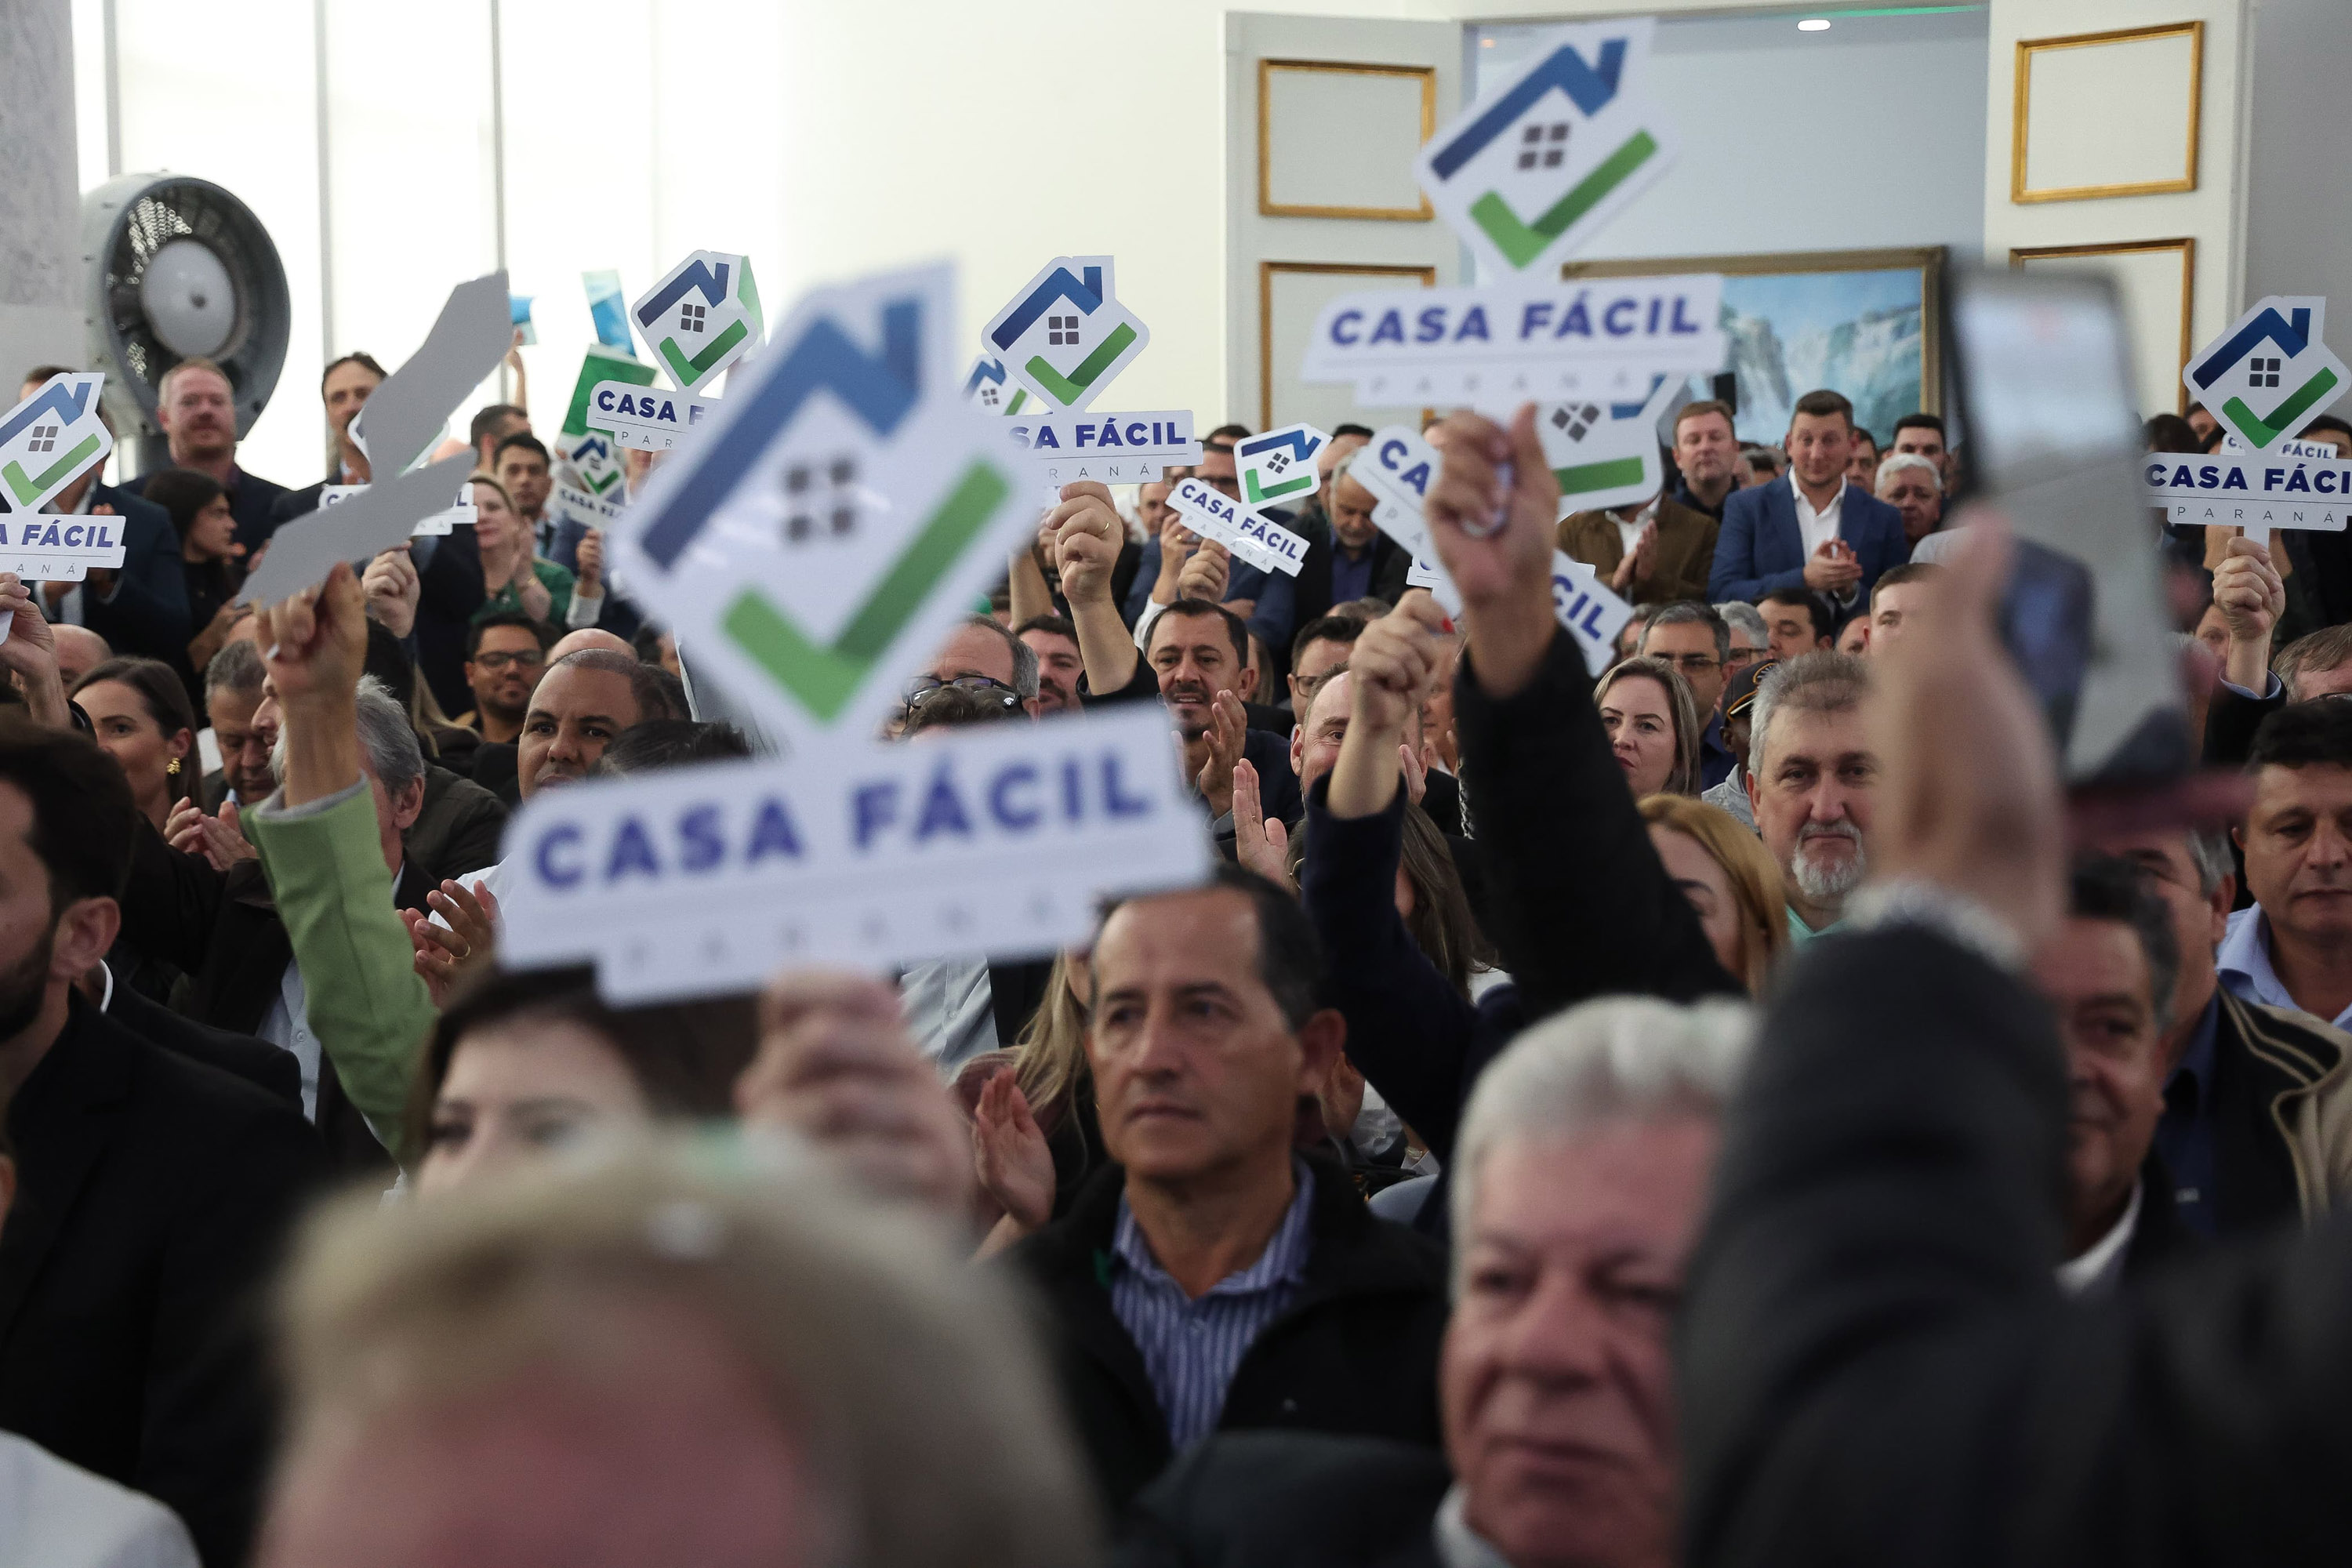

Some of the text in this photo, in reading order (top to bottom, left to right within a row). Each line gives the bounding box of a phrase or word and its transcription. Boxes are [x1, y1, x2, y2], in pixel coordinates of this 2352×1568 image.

[1329, 289, 1700, 346] CASA FÁCIL
[597, 390, 677, 423] CASA
[622, 432, 673, 448] PAR
[1009, 417, 1186, 449] SA FÁCIL
[2282, 441, 2332, 459] FÁCIL
[1049, 463, 1150, 479] RANÁ
[2144, 463, 2351, 494] CASA FÁCI
[1181, 485, 1298, 560] CASA FÁCIL
[2177, 507, 2334, 524] PARANÁ
[22, 519, 113, 547] FÁCIL
[1187, 515, 1268, 565] PARANÁ
[1380, 439, 1604, 640] CA CIL
[16, 563, 75, 575] ANÁ
[533, 749, 1153, 891] CASA FÁCIL
